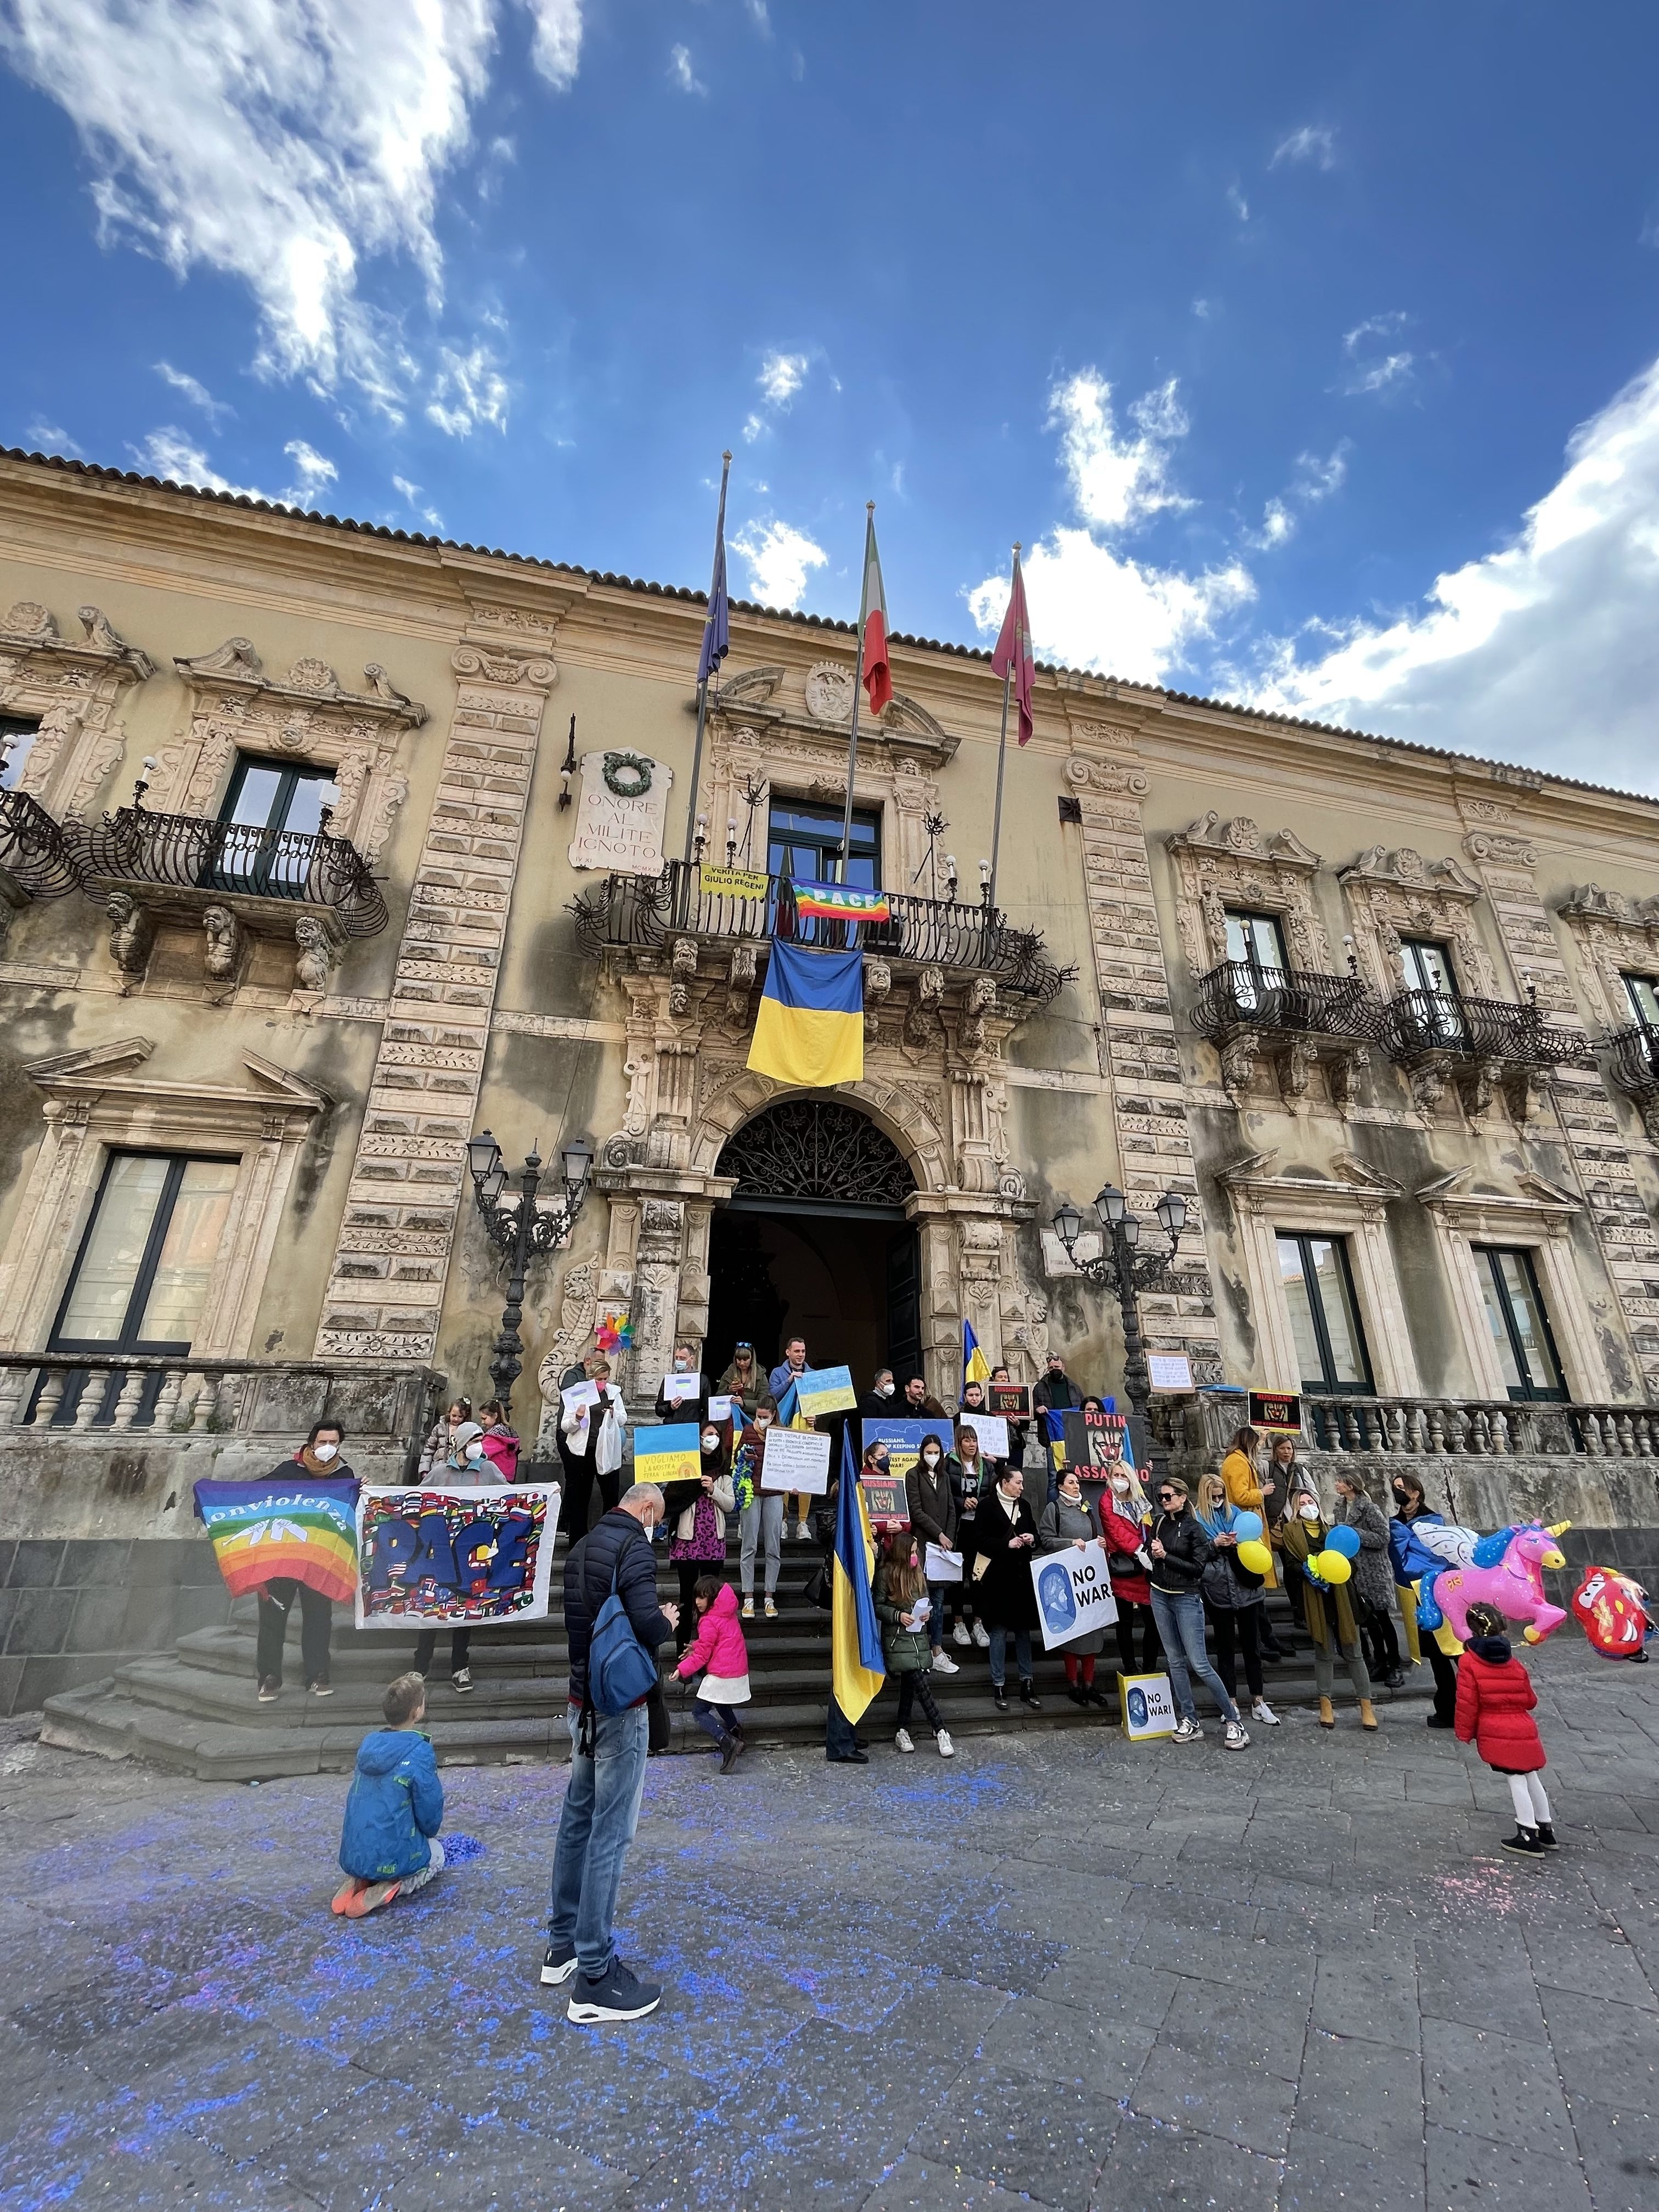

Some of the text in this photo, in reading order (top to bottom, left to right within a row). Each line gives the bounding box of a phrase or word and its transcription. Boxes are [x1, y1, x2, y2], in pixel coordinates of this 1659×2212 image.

[588, 794, 658, 815] ONORE
[608, 812, 634, 826] AL
[587, 823, 653, 844] MILITE
[578, 837, 656, 859] IGNOTO
[704, 874, 764, 890] GIULIO REGENI
[814, 890, 875, 909] PACE
[1256, 1393, 1293, 1402] RUSSIANS
[1085, 1413, 1126, 1428] PUTIN
[645, 1454, 686, 1464] VOGLIAMO
[863, 1480, 897, 1488] RUSSIANS
[206, 1493, 348, 1532] onviolenza
[370, 1515, 534, 1594] PACE
[1073, 1566, 1095, 1587] NO
[1147, 1693, 1161, 1703] NO
